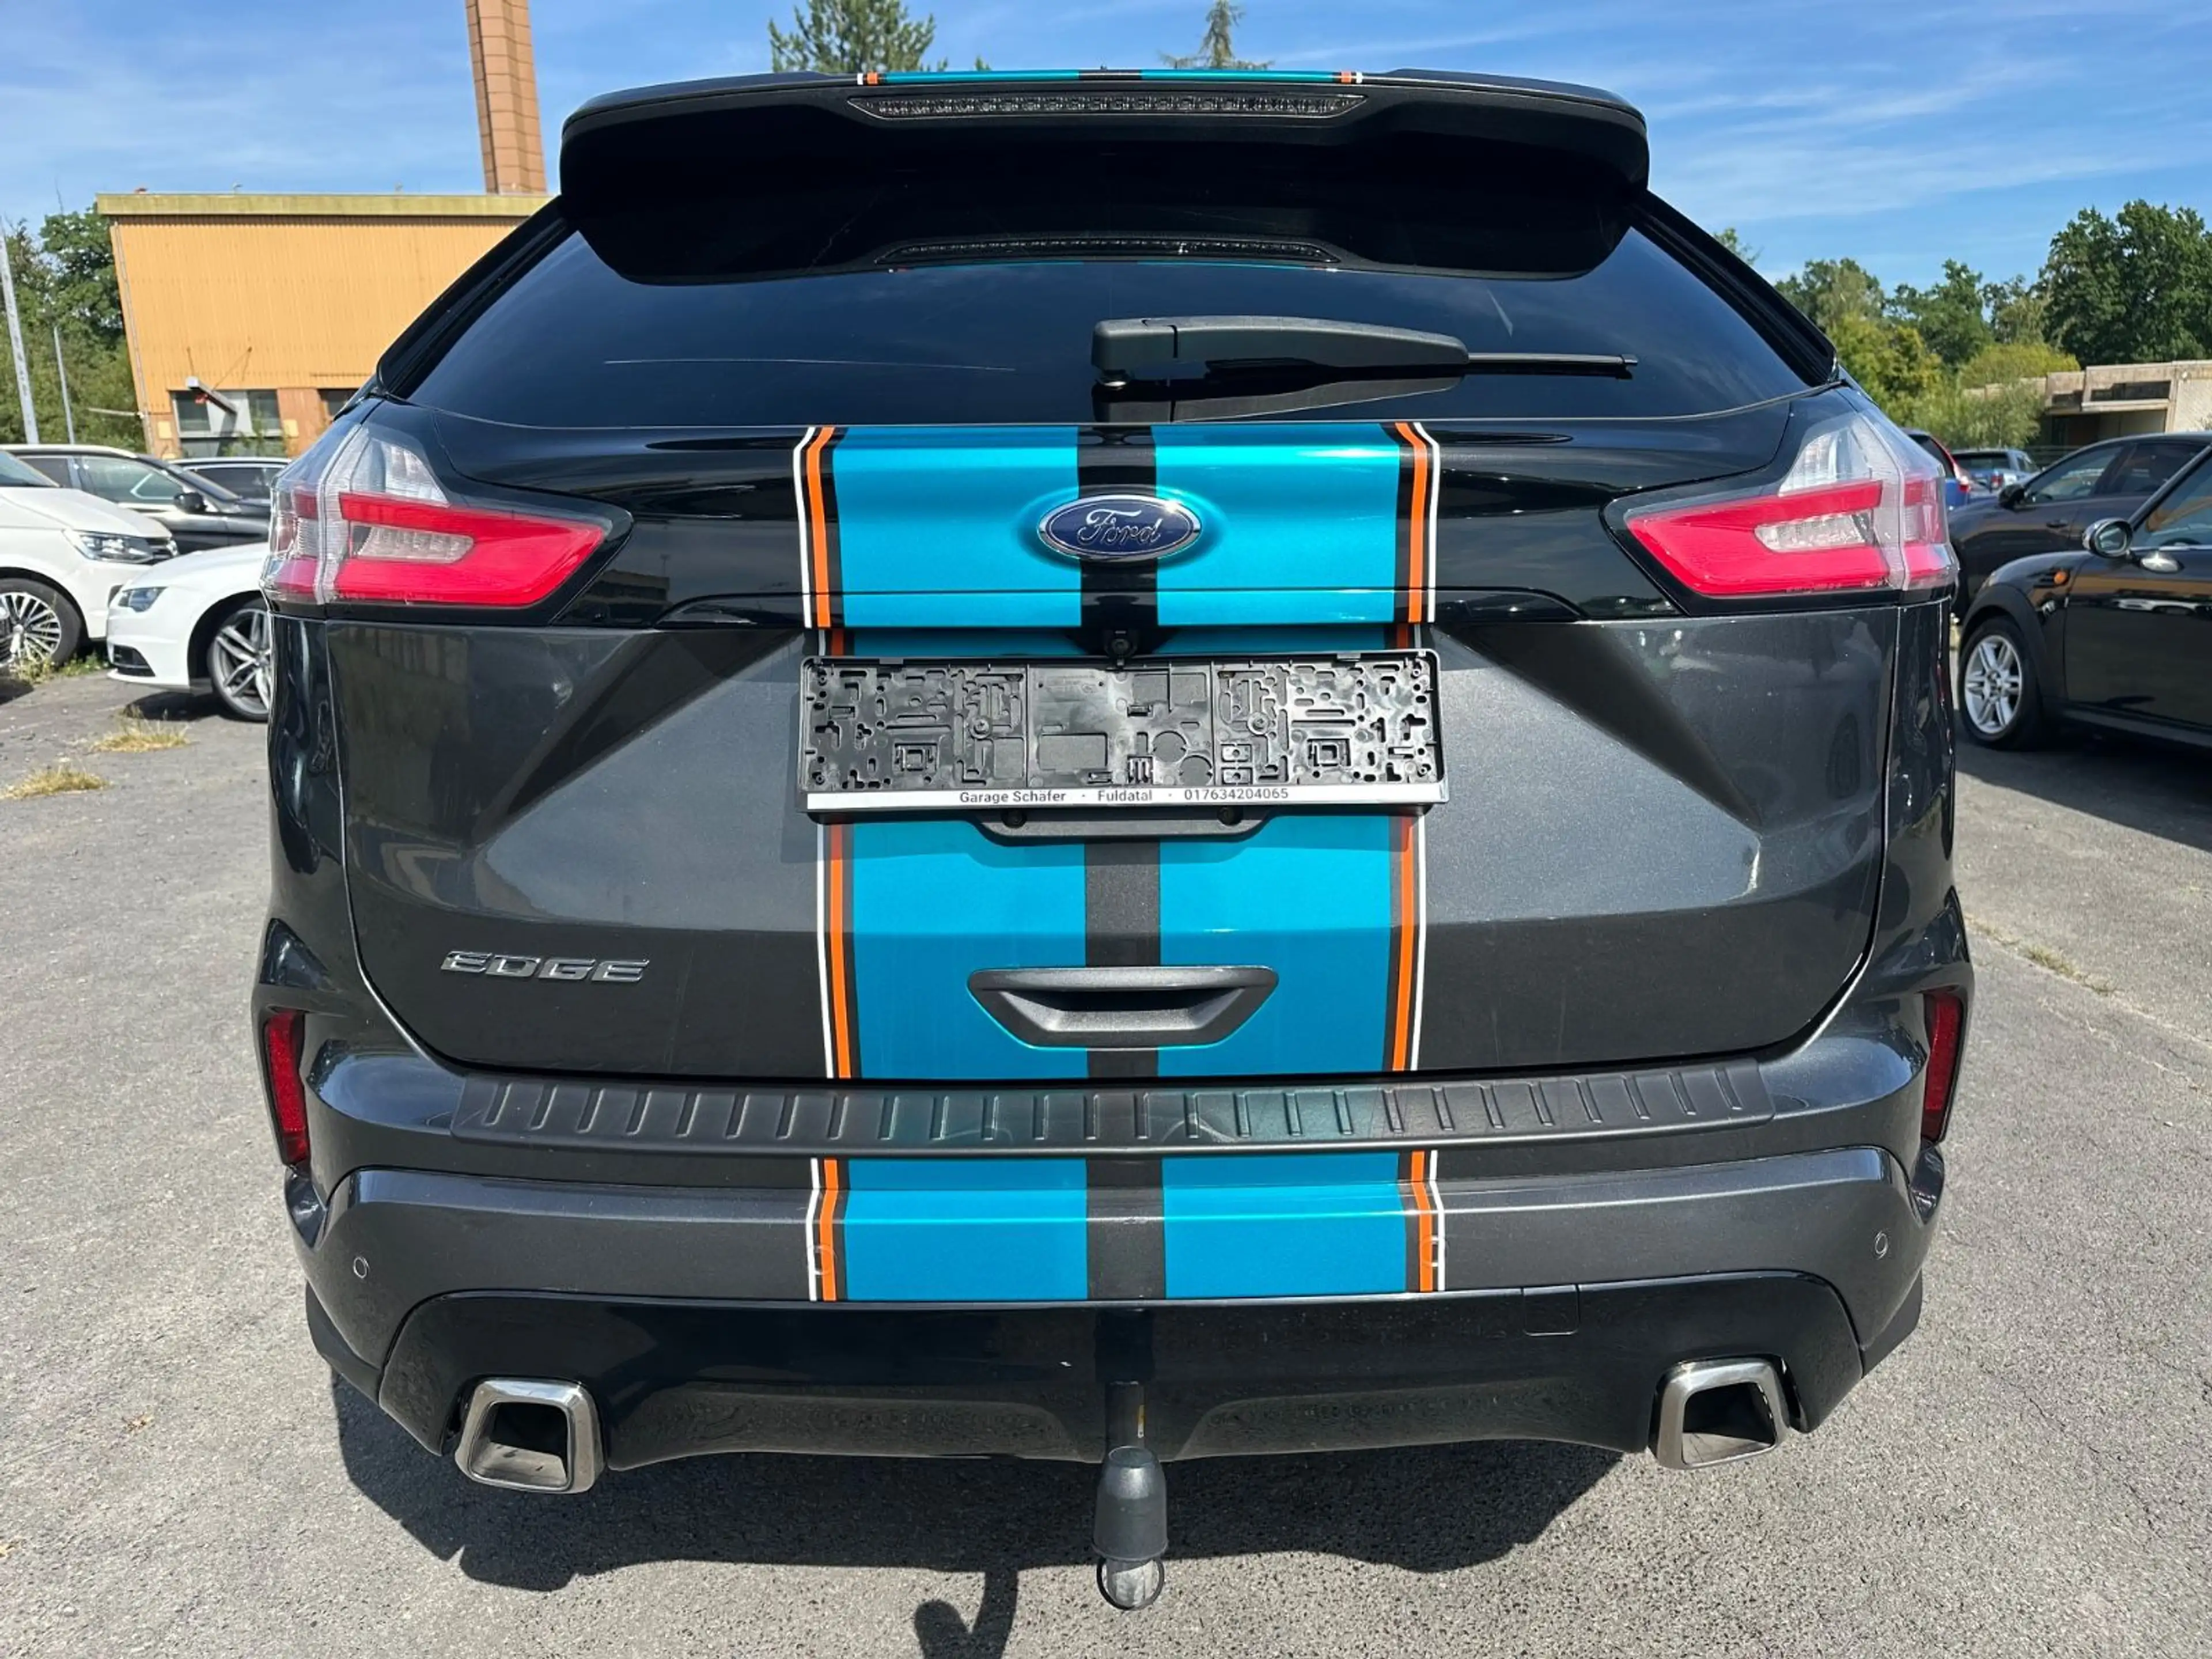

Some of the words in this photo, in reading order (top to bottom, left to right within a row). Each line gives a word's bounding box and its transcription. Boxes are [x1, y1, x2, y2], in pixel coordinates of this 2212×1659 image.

[1077, 508, 1164, 545] Ford
[960, 791, 1008, 804] Garage
[1097, 790, 1152, 801] Fuldatal
[1184, 788, 1289, 800] 017634204065
[441, 950, 650, 982] EDGE
